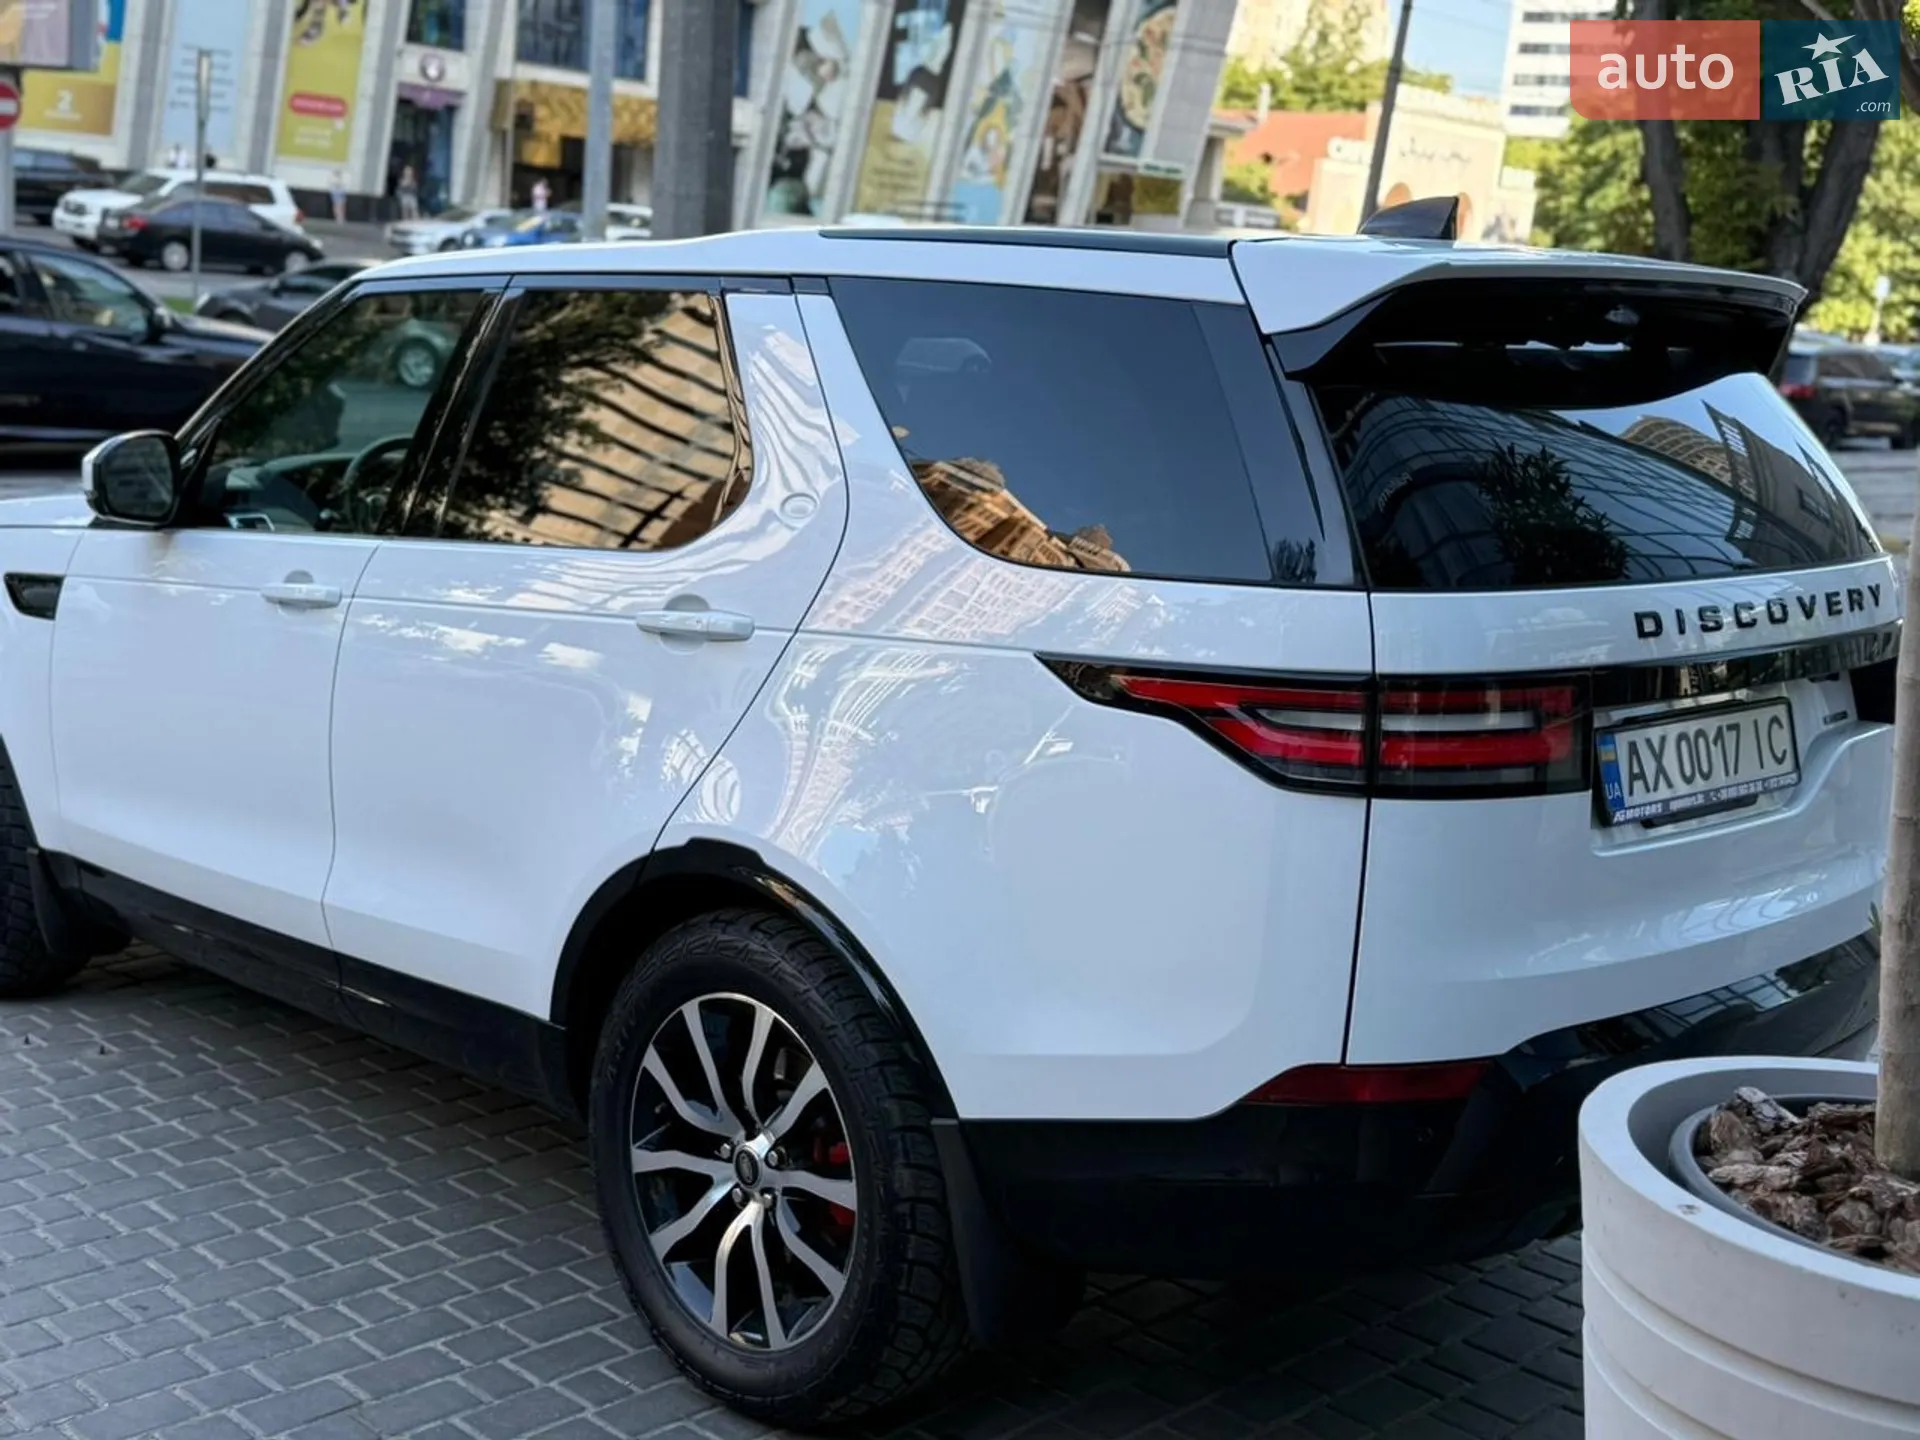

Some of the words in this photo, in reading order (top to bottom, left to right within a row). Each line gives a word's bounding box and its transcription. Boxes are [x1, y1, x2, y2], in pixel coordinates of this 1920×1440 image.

[1634, 583, 1881, 639] DISCOVERY
[1628, 734, 1674, 797] AX
[1675, 722, 1742, 786] 0017
[1753, 714, 1788, 770] IC
[1606, 782, 1622, 800] UA
